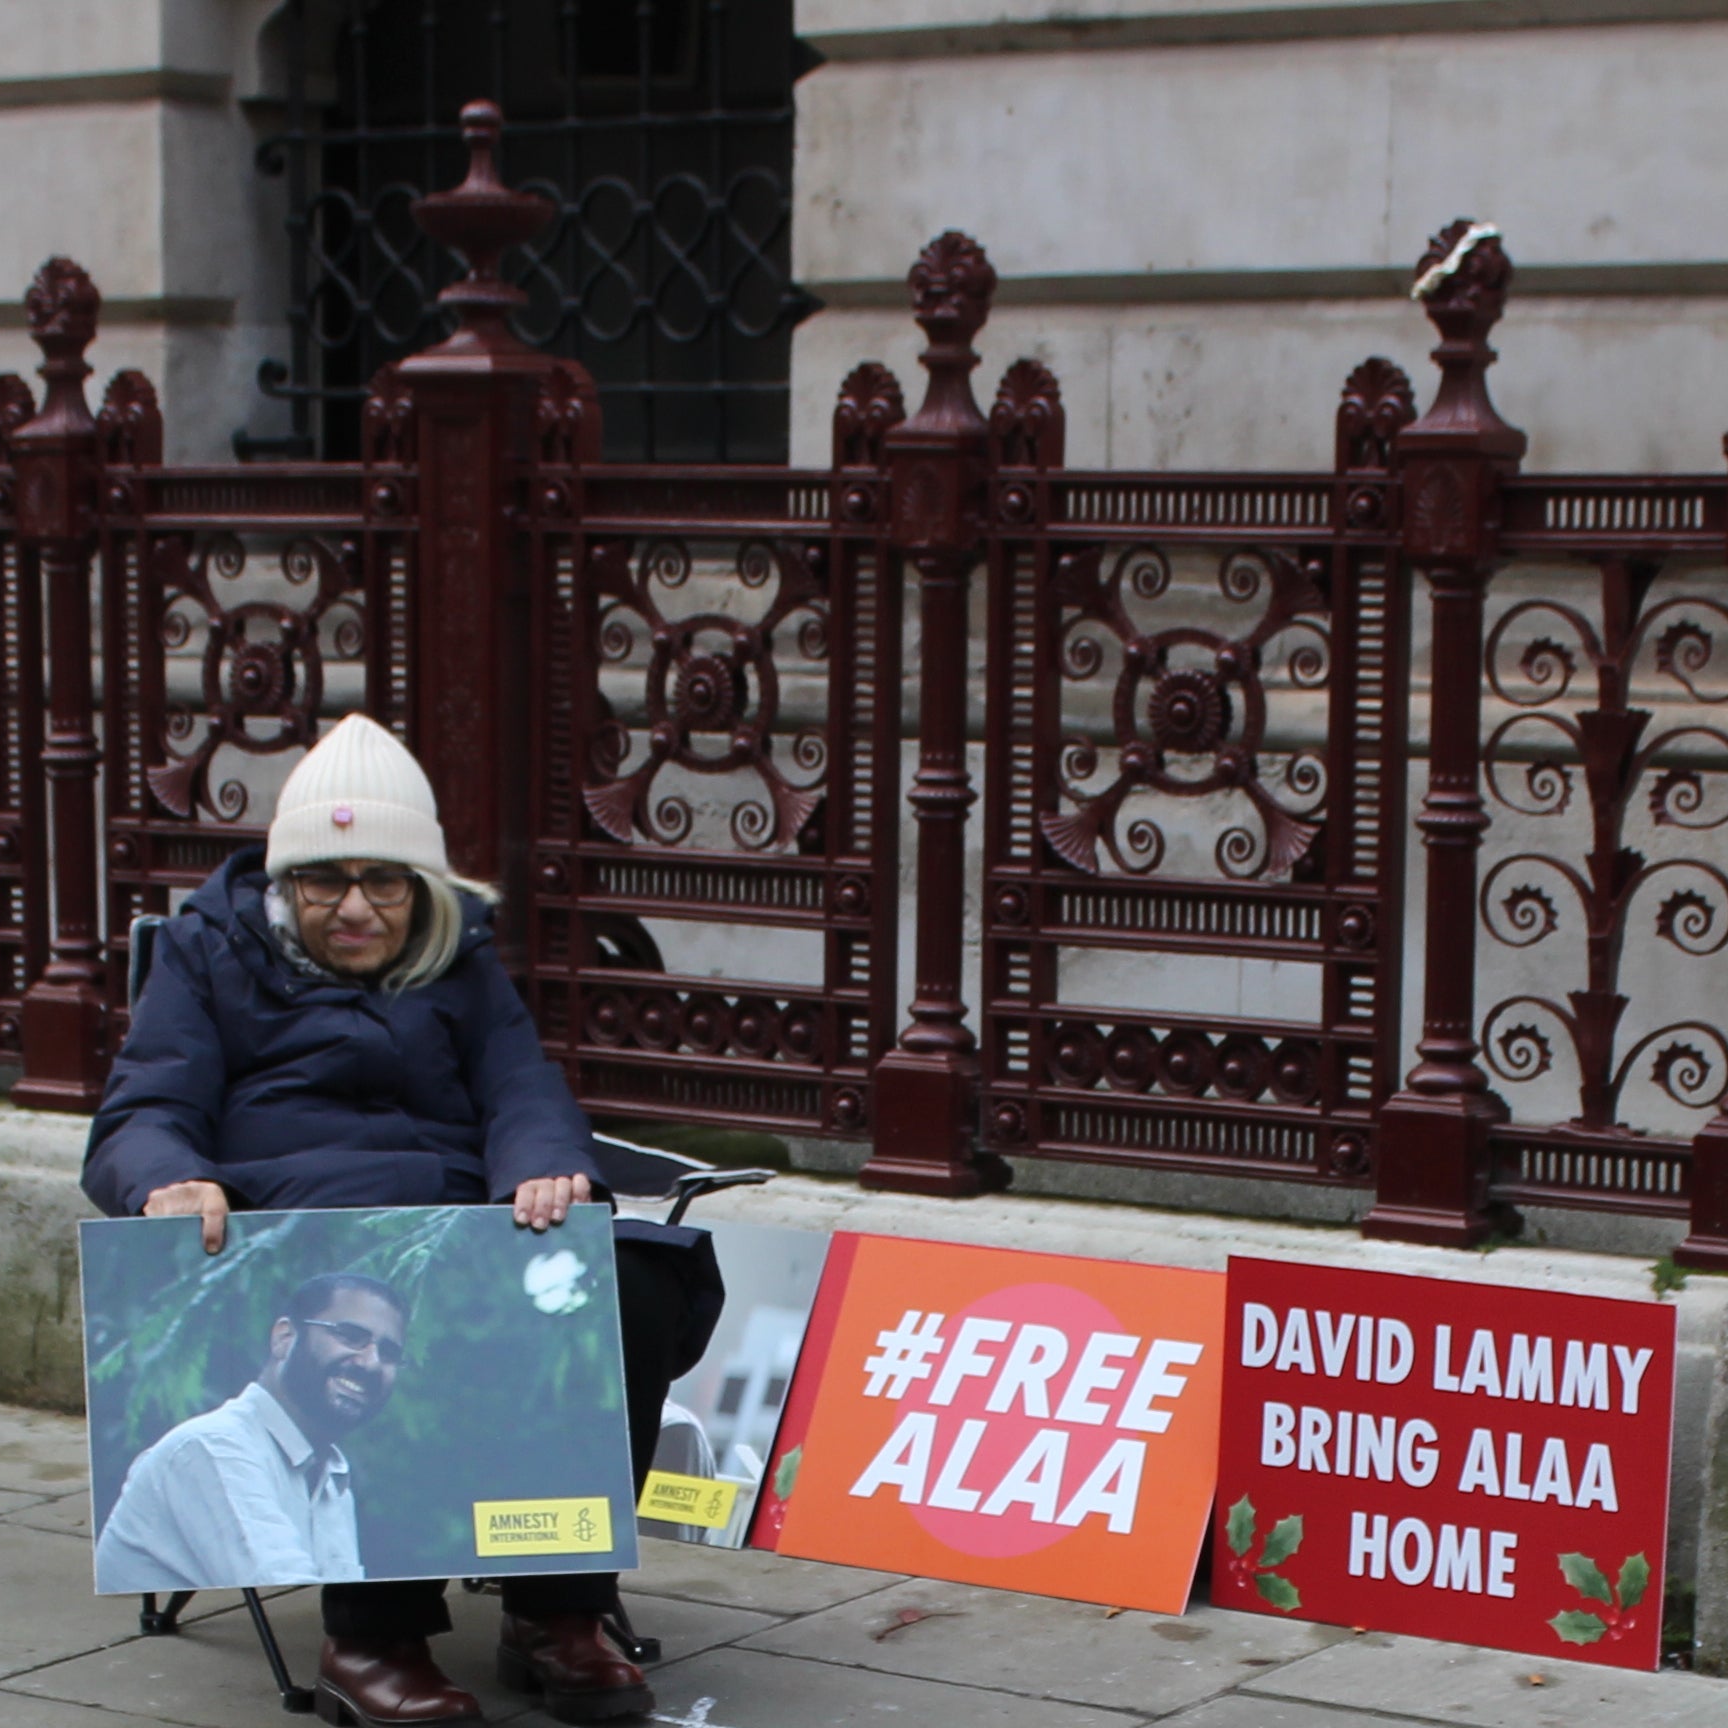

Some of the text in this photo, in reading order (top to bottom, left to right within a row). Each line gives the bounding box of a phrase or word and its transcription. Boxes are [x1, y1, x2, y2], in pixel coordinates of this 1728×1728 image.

[862, 1309, 1205, 1434] #FREE
[1240, 1301, 1654, 1414] DAVID LAMMY
[653, 1483, 701, 1504] AMNESTY
[847, 1411, 1147, 1535] ALAA
[1260, 1401, 1619, 1512] BRING ALAA
[488, 1511, 559, 1531] AMNESTY
[489, 1531, 560, 1544] INTERNATIONAL
[1347, 1511, 1518, 1599] HOME
